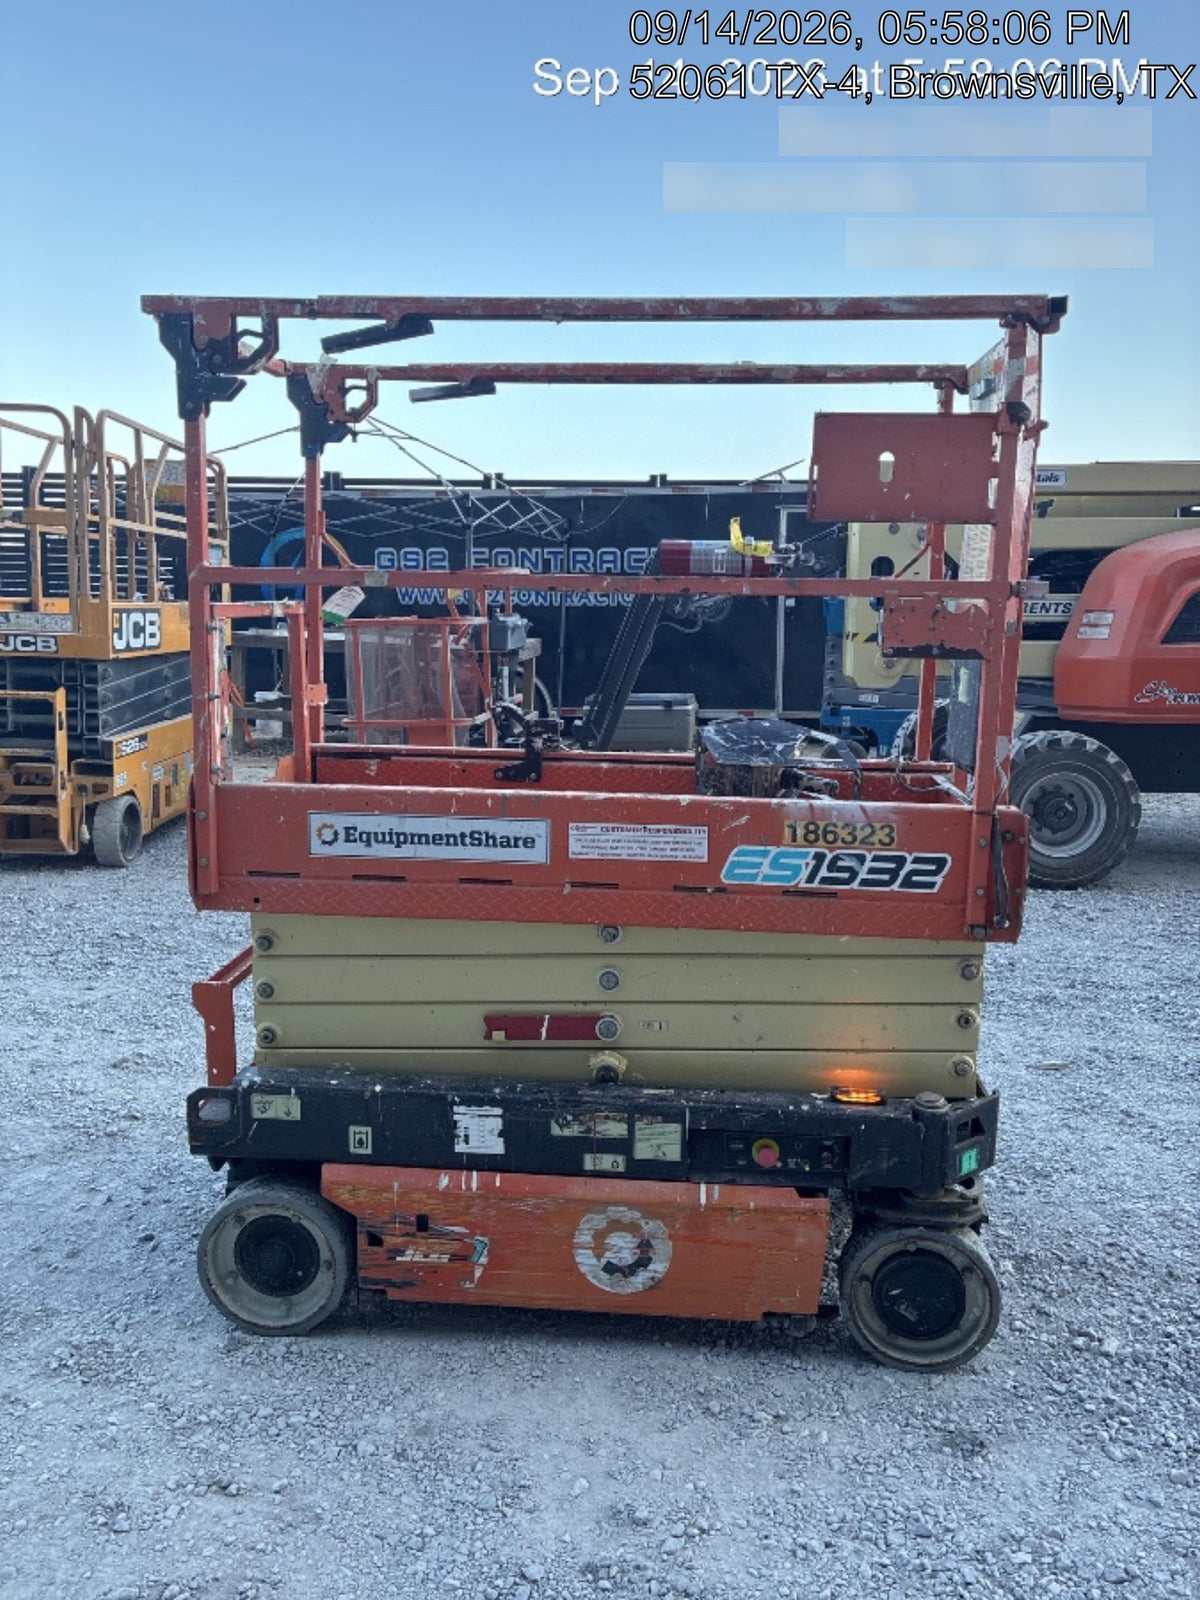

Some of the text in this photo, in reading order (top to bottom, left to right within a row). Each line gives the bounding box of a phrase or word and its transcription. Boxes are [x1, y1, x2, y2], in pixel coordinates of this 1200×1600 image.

[375, 547, 658, 575] GS2 CONTRAC
[0, 636, 57, 652] JCB
[113, 612, 160, 650] JCB
[343, 826, 535, 849] EquipmentShare
[785, 821, 896, 847] 186323
